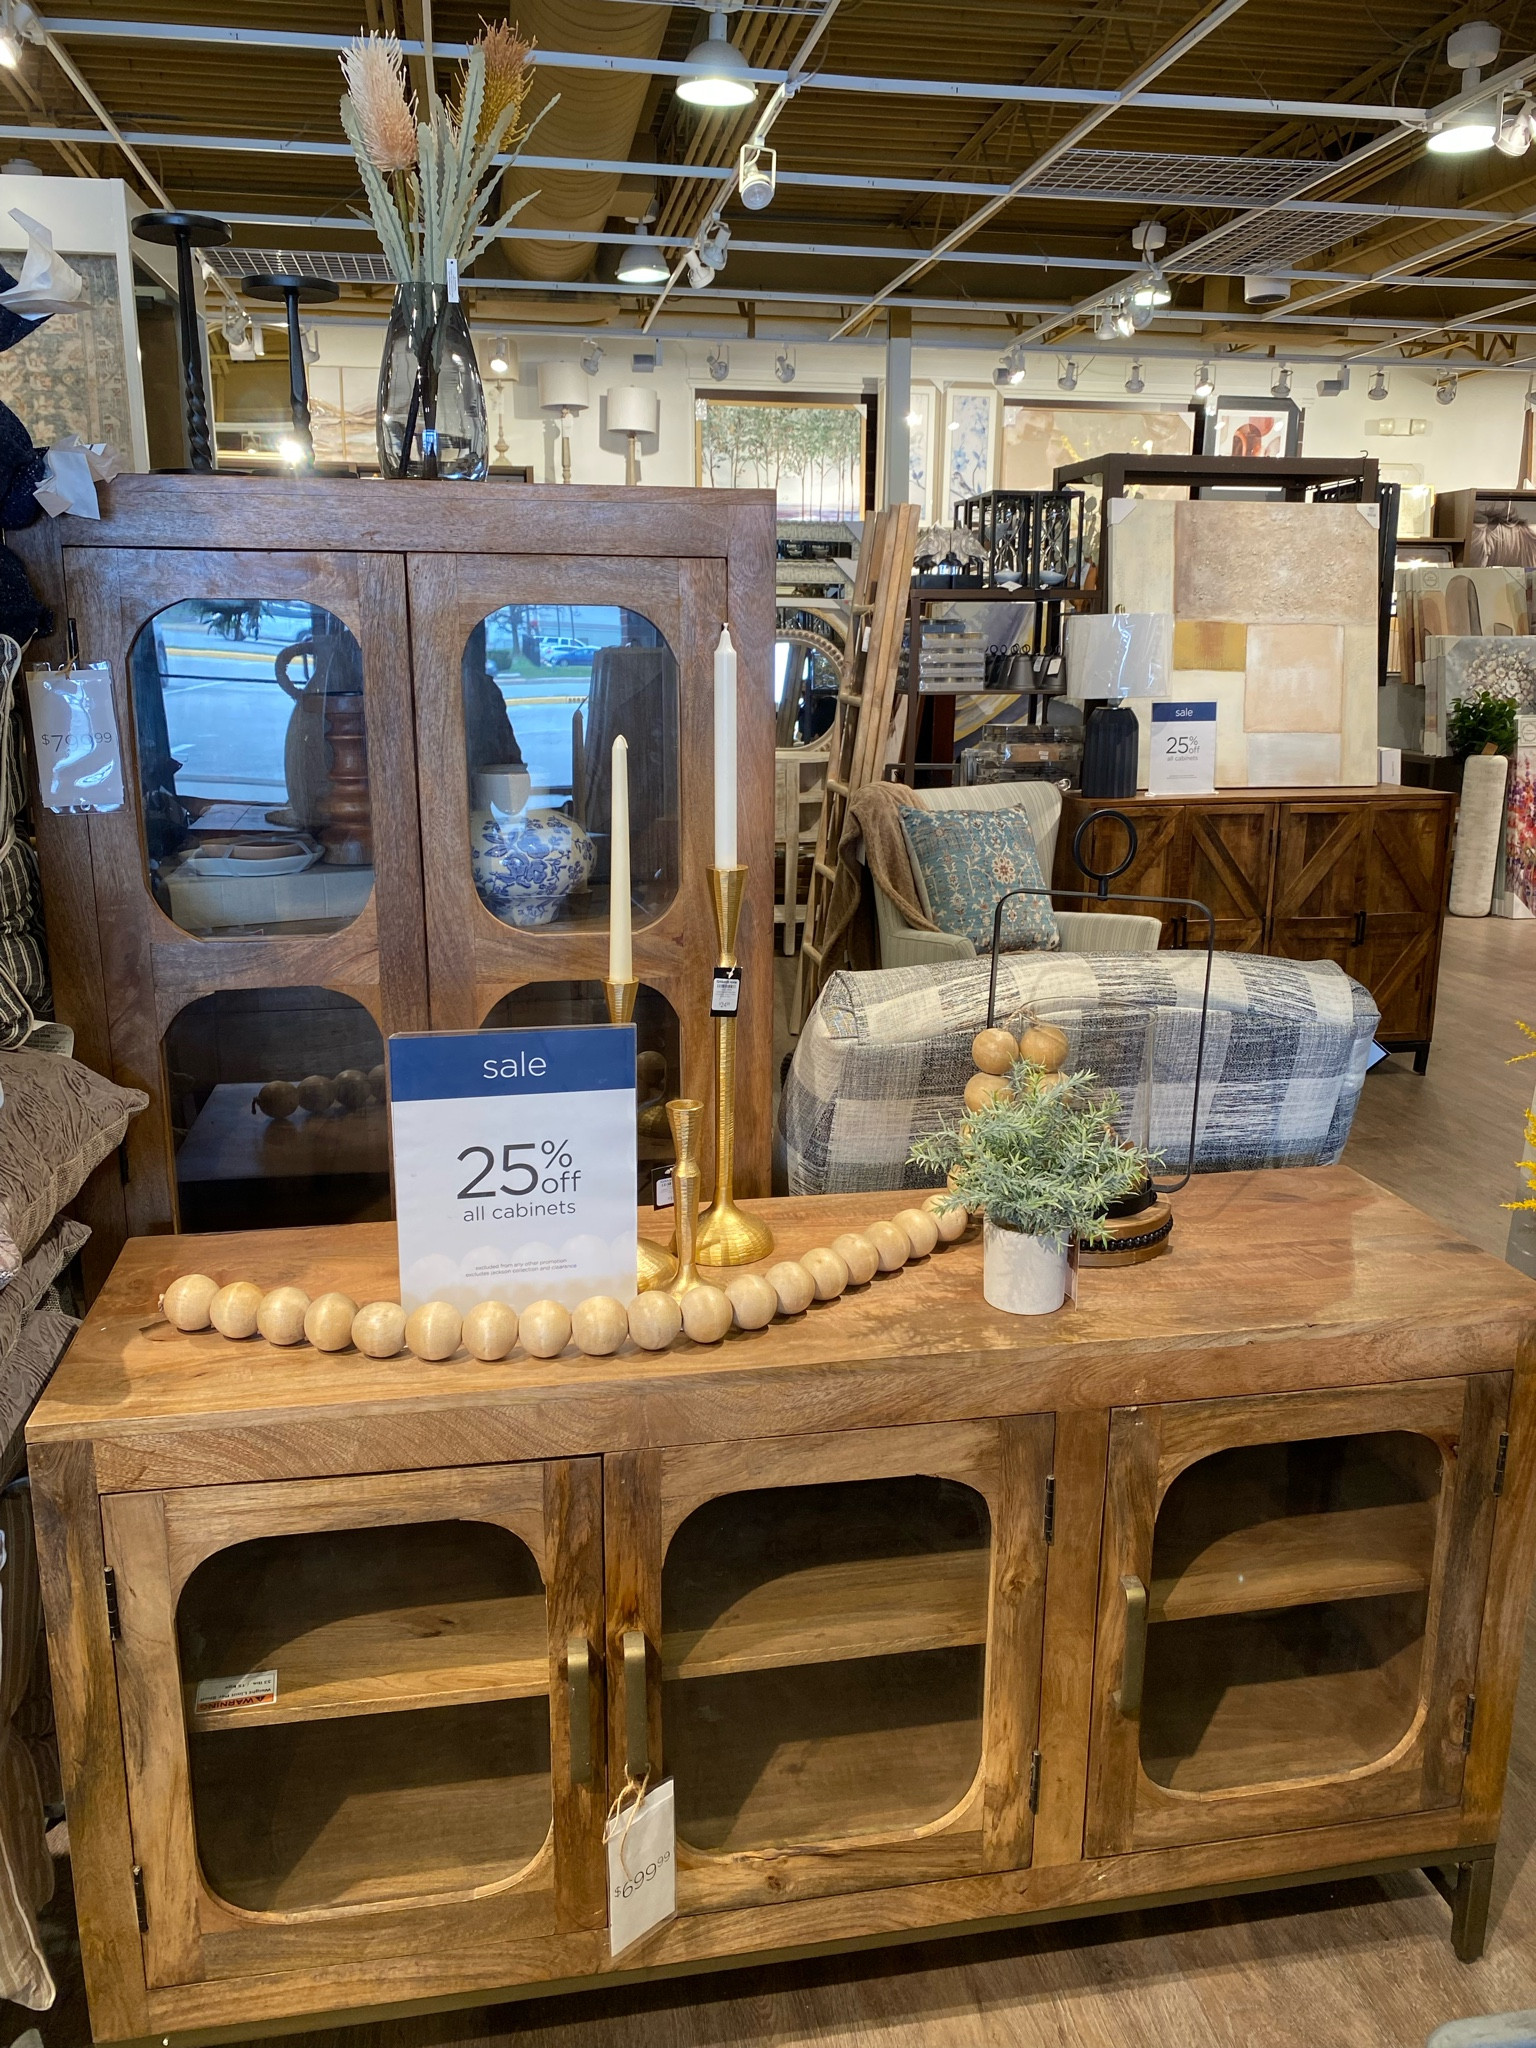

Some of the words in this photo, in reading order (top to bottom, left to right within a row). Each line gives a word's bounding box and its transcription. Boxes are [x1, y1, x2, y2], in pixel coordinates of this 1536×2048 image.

[1175, 707, 1194, 717] sale
[1166, 736, 1199, 754] 25%
[1188, 746, 1200, 754] off
[483, 1051, 547, 1079] sale
[457, 1139, 573, 1199] 25%
[541, 1170, 582, 1194] off
[463, 1206, 485, 1222] all
[492, 1200, 576, 1221] cabinets
[199, 1696, 254, 1710] WARNING
